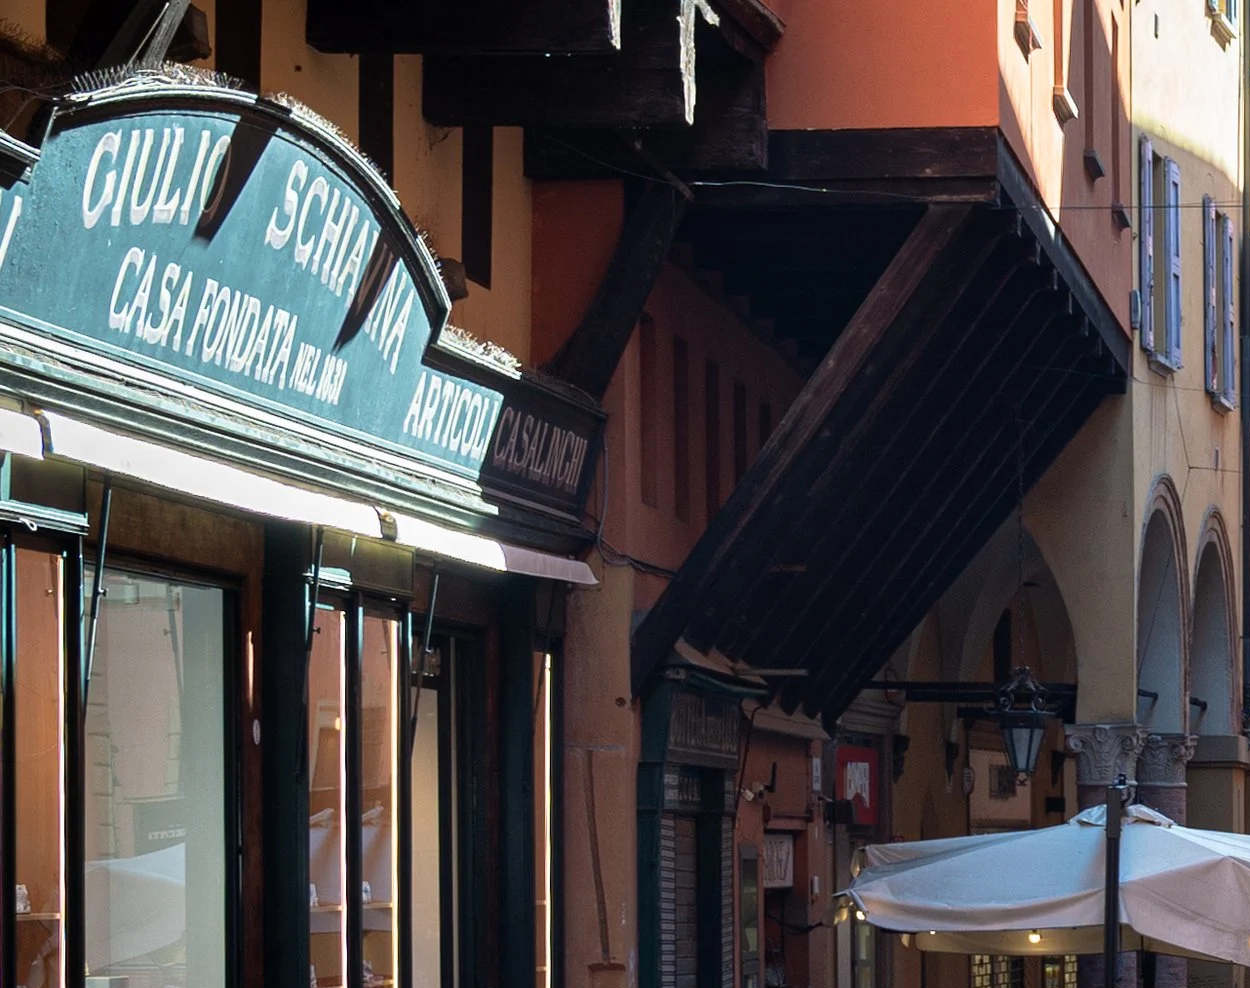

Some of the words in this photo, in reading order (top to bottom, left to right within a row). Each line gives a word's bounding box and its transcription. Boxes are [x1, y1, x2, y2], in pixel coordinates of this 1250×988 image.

[82, 128, 232, 229] GIULIO
[108, 246, 194, 353] CASA
[185, 278, 298, 390] FONDATA
[288, 342, 322, 396] NEL
[403, 371, 500, 462] ARTICOLI
[492, 406, 588, 496] CASALINGHI
